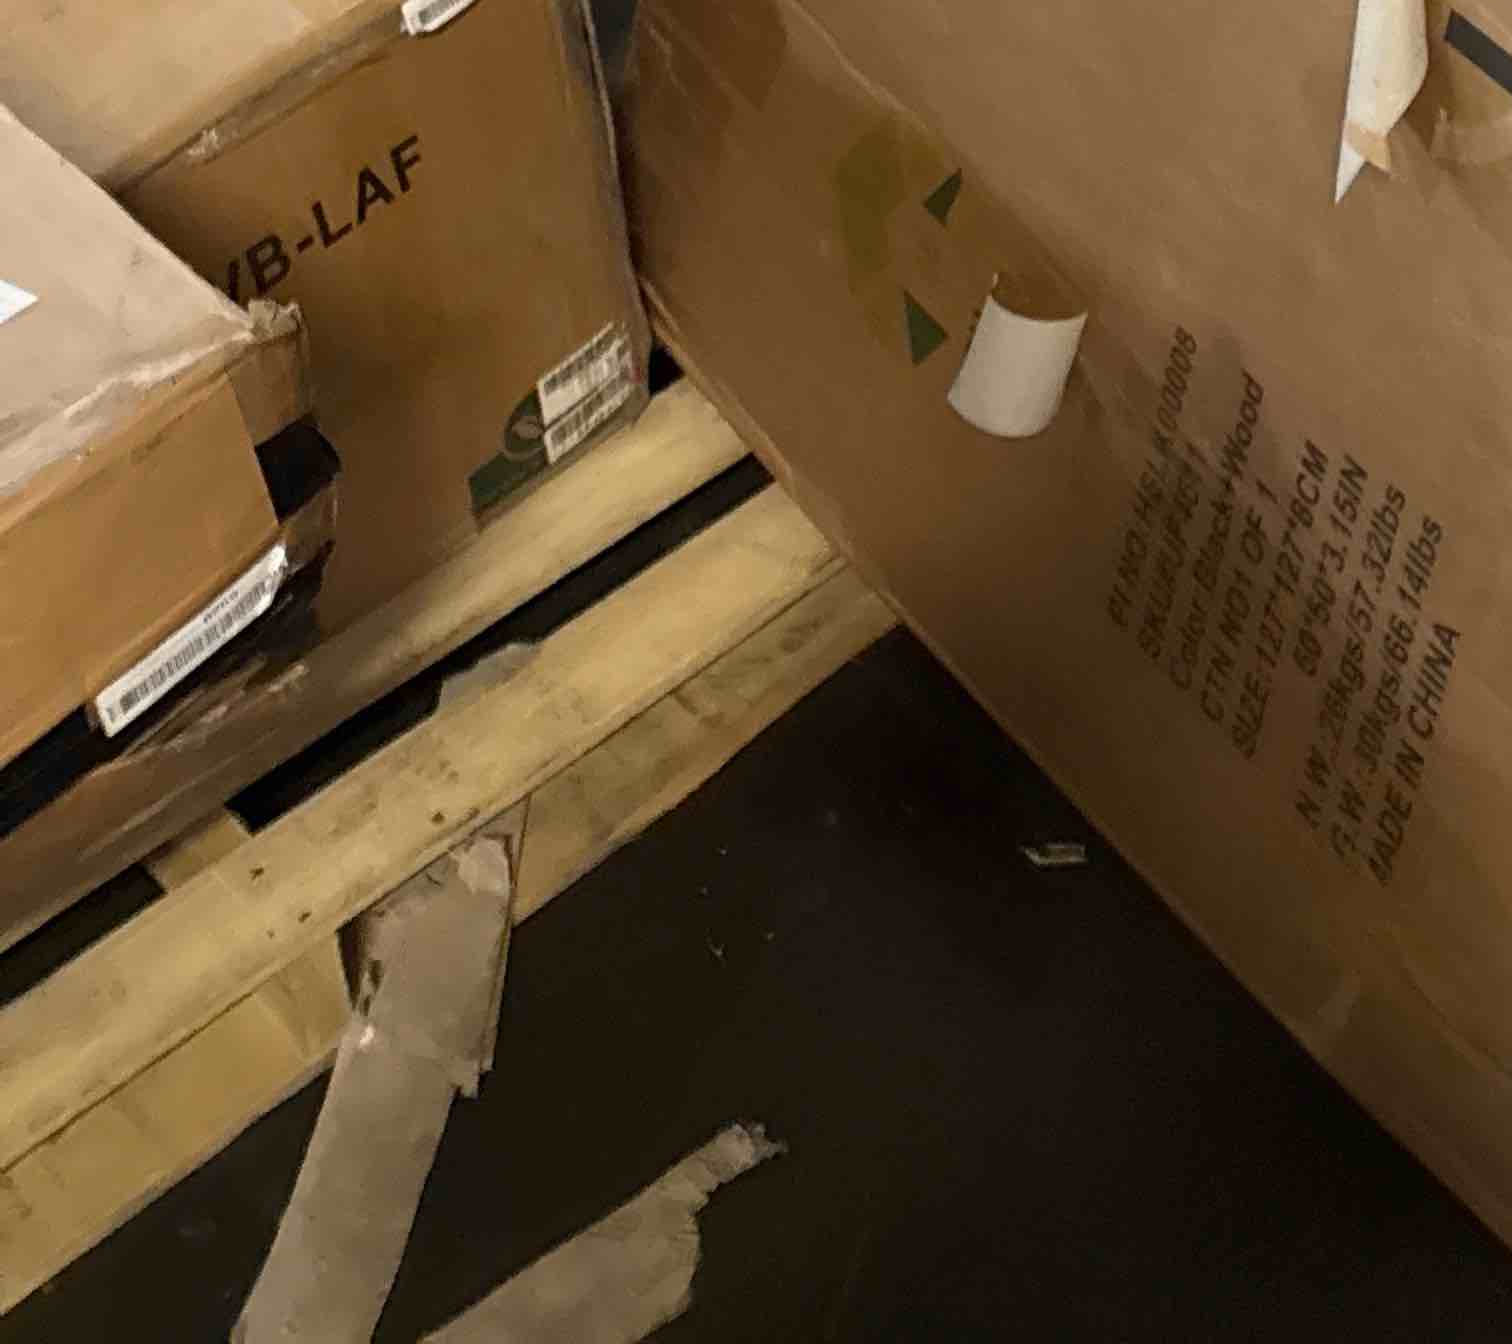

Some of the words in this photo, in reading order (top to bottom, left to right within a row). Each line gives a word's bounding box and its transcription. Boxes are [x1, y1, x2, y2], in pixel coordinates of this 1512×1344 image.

[1244, 508, 1267, 563] OF
[1409, 621, 1461, 741] CHINA
[1396, 744, 1425, 793] IN
